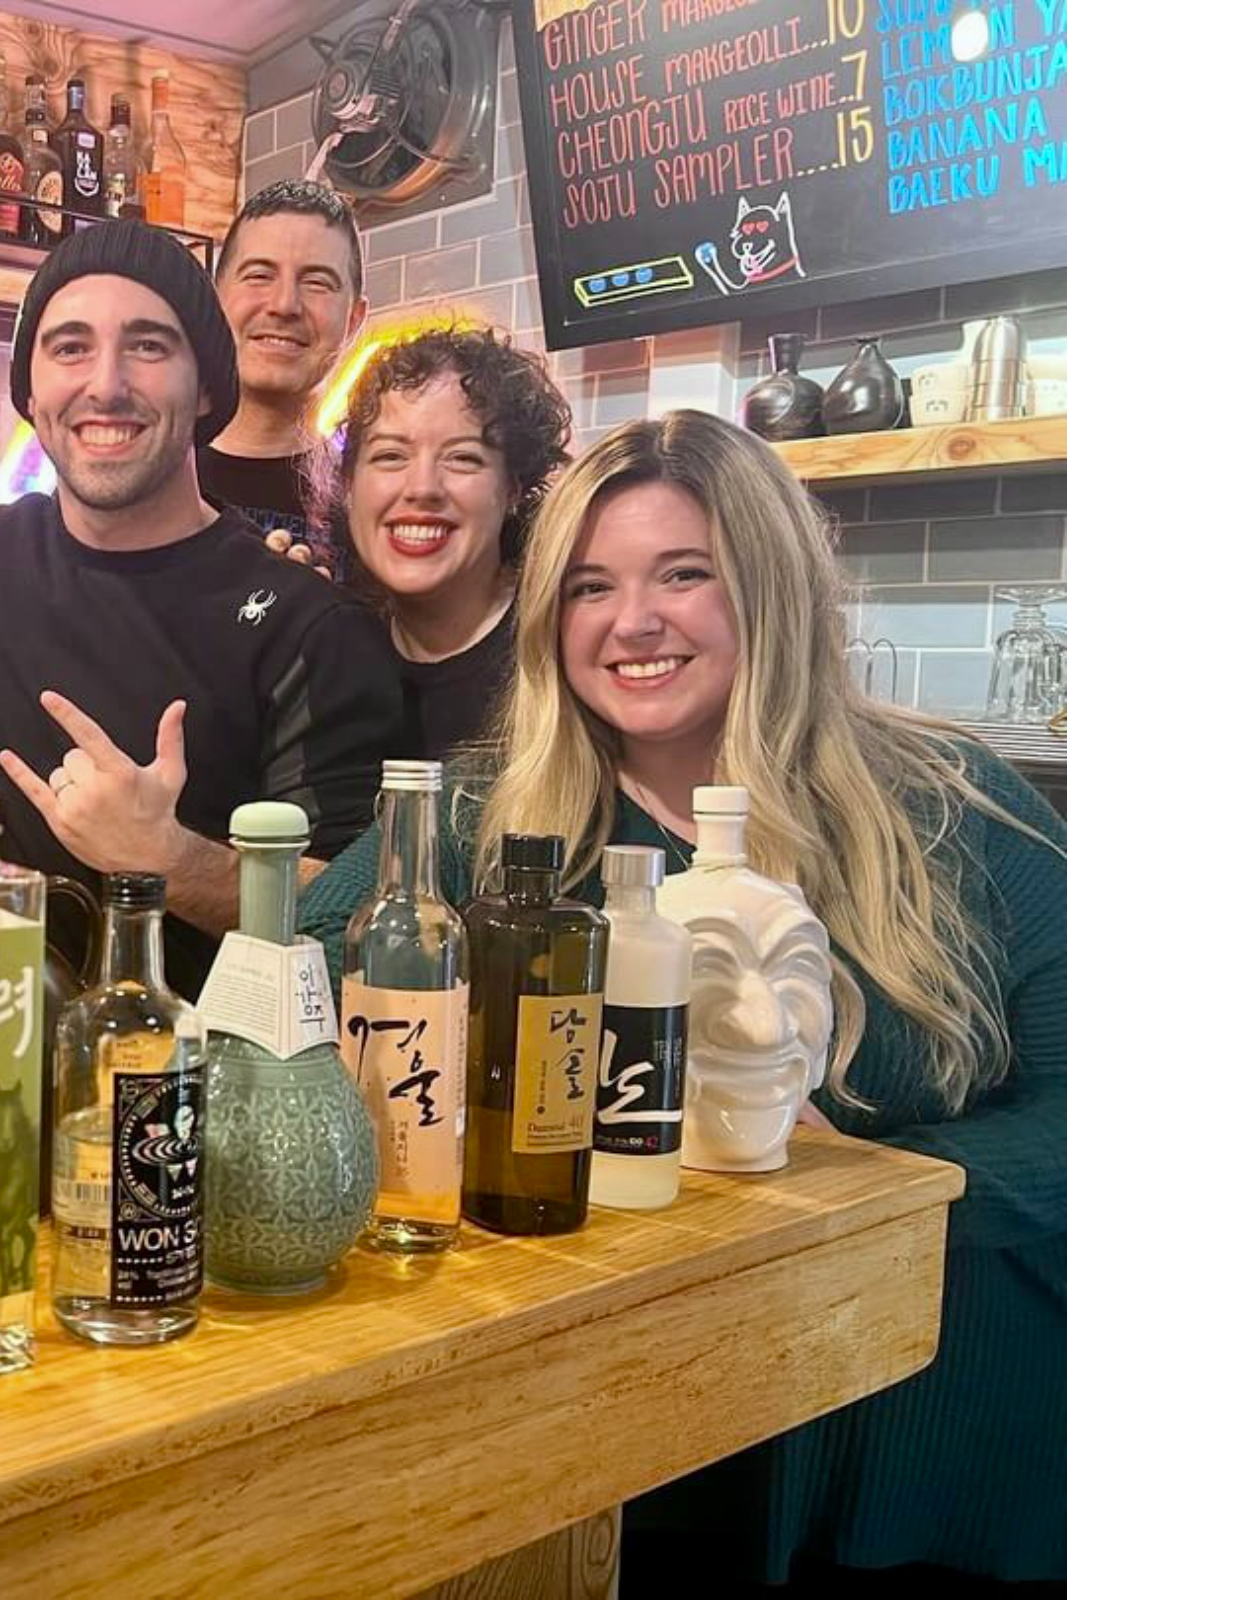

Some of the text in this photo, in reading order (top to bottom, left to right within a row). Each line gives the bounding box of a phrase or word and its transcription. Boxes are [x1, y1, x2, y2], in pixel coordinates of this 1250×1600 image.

[544, 0, 647, 70] GINGER
[550, 54, 647, 127] HOUSE
[664, 17, 802, 93] MAKGEOLLI
[882, 4, 1015, 80] LEMN
[1038, 0, 1067, 36] Y
[557, 89, 707, 179] CHEONGJU
[724, 93, 768, 134] RICE
[777, 73, 837, 120] WINE
[887, 96, 1047, 171] BANANA
[563, 106, 874, 230] SOJU SAMPLER 15
[888, 155, 1000, 215] BAEKU
[117, 1225, 180, 1251] WON
